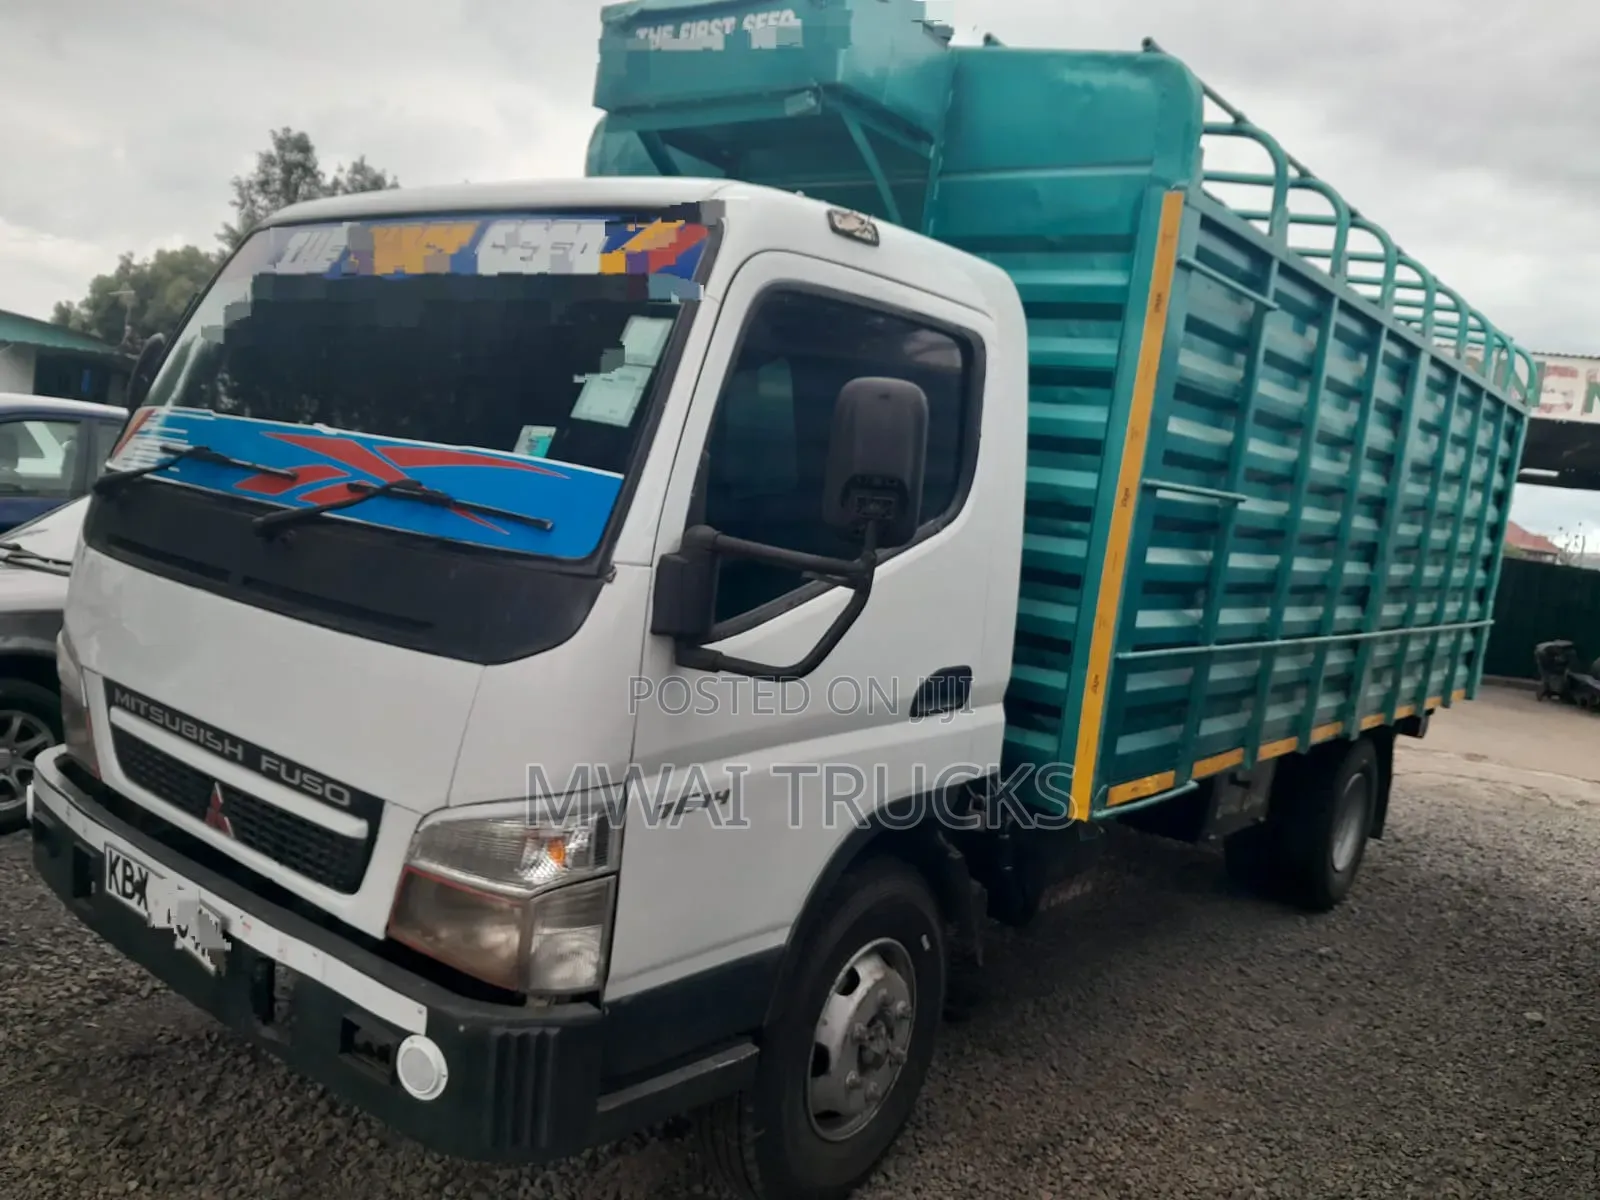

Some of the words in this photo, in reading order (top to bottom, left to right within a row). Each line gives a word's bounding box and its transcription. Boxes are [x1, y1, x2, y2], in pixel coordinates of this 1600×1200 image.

[635, 25, 674, 48] THE
[679, 16, 736, 42] FIRST
[113, 687, 244, 763] MITSUBISH
[260, 753, 351, 807] FUSO
[107, 849, 149, 912] KBX
